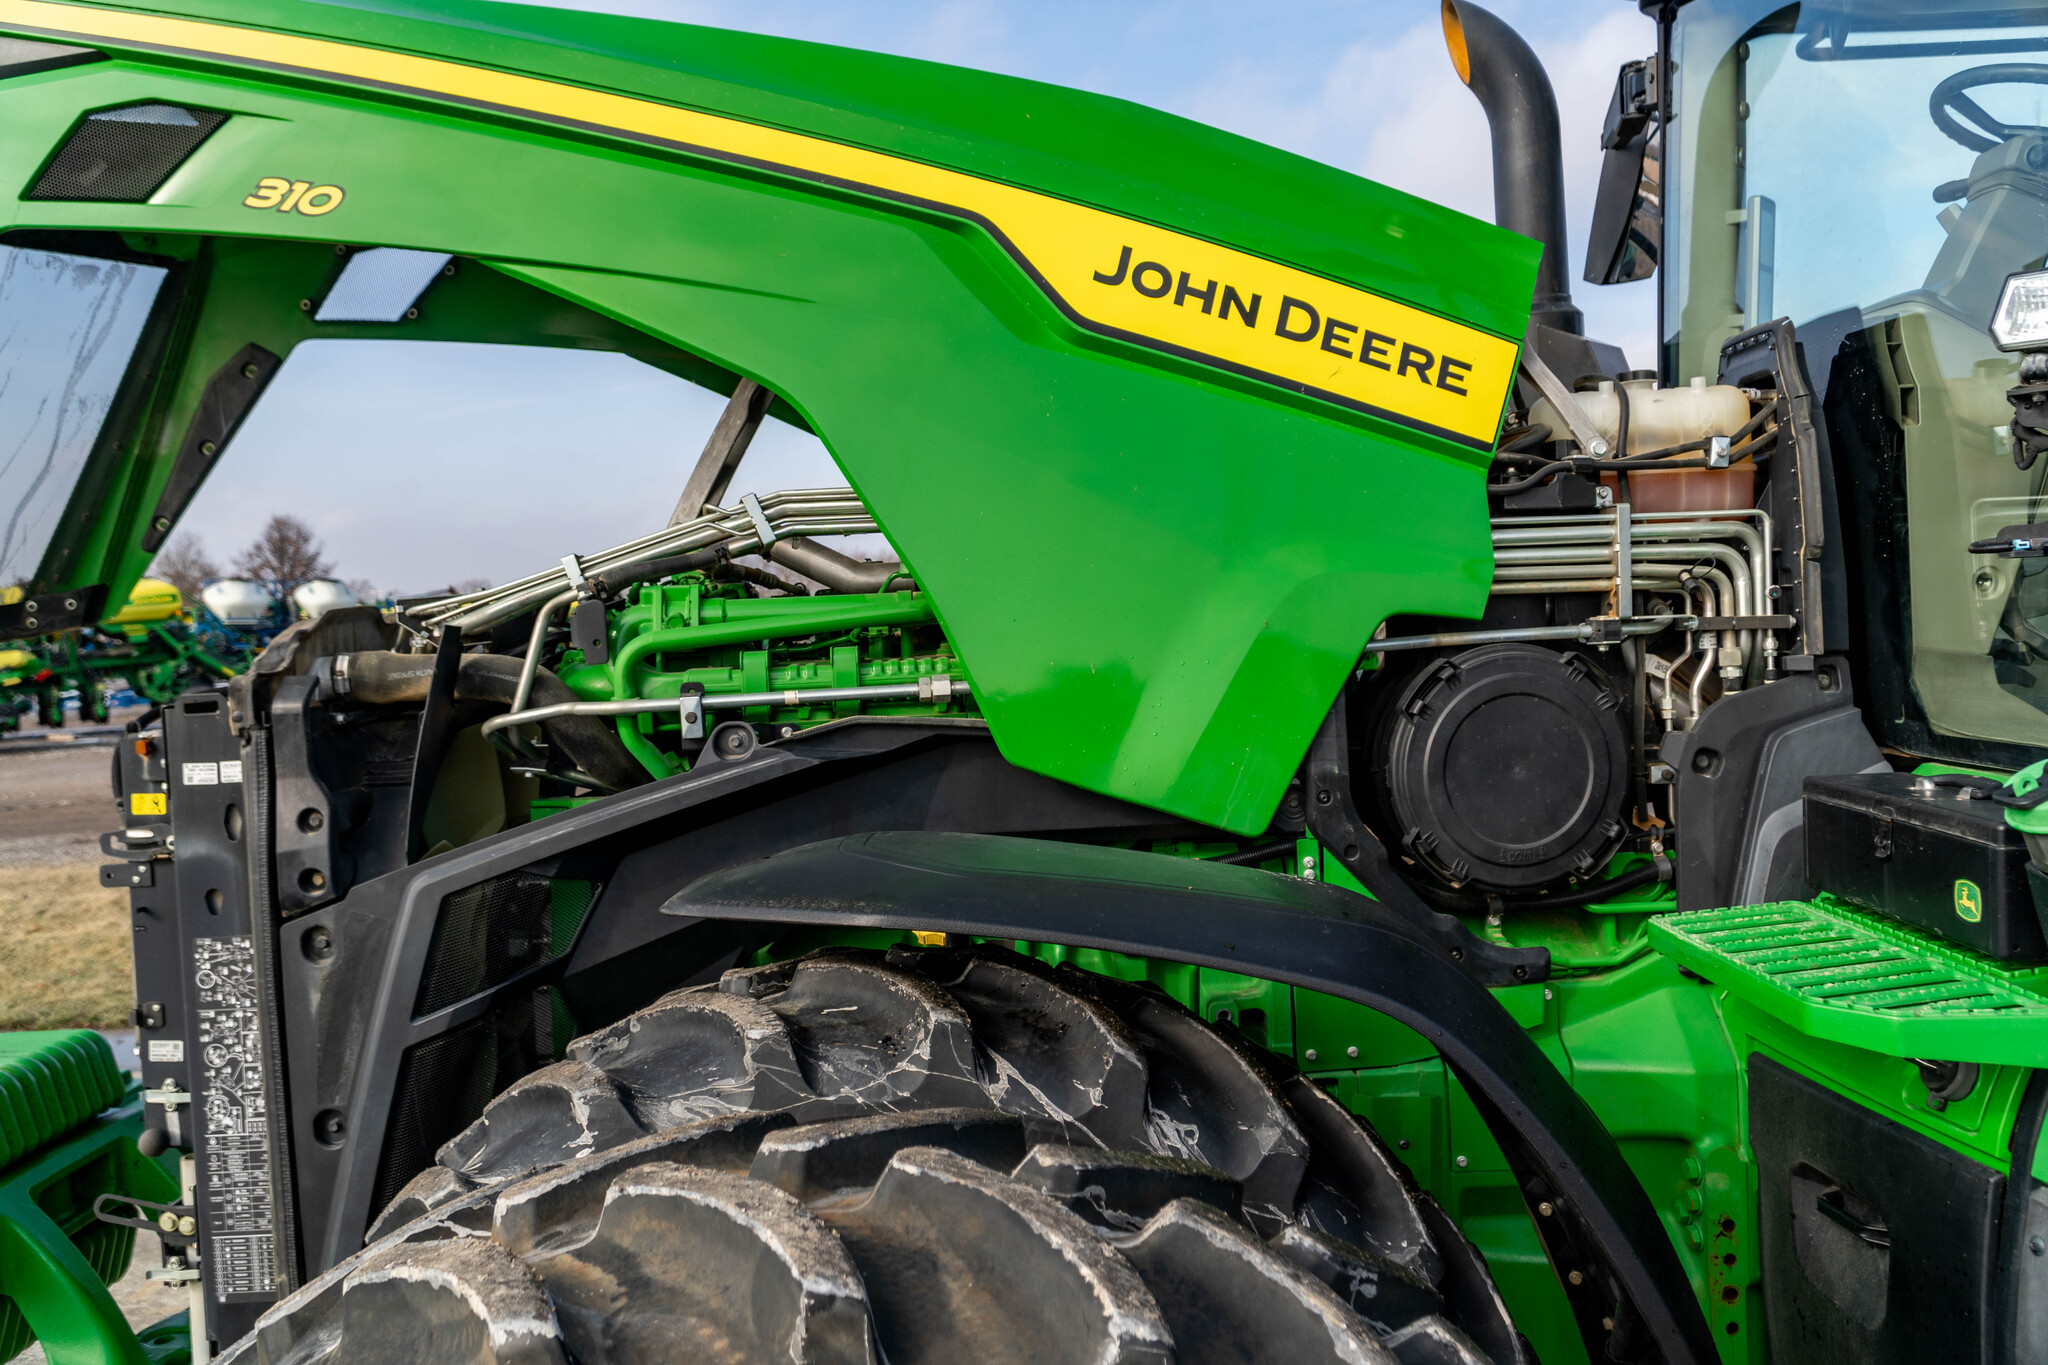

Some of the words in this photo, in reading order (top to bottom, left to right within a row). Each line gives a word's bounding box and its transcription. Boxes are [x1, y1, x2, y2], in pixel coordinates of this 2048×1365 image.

[242, 177, 346, 216] 310
[1093, 246, 1262, 328] JOHN
[1275, 295, 1473, 396] DEERE
